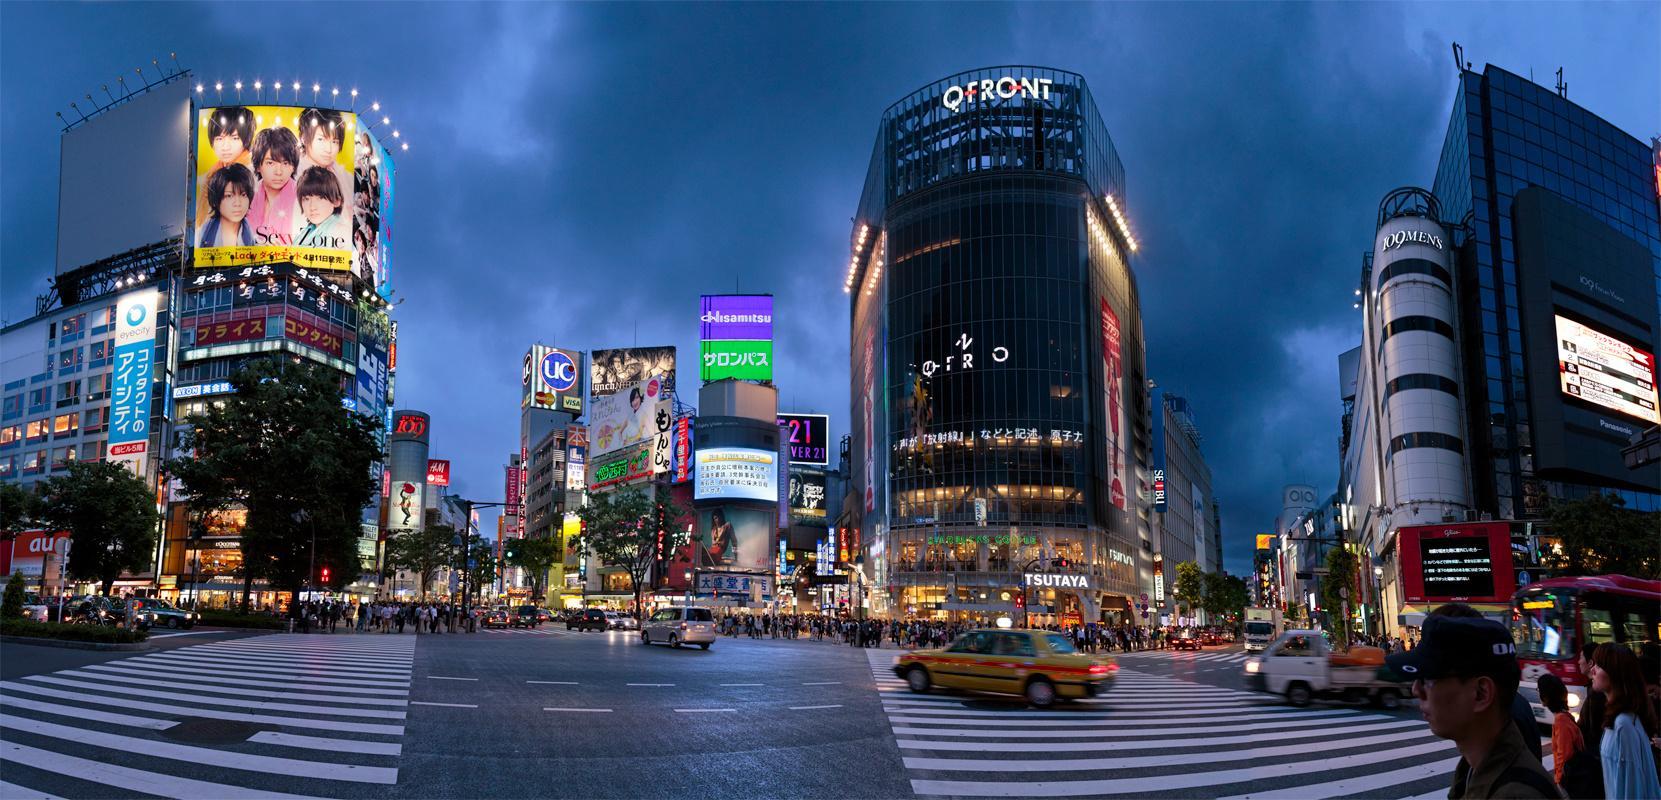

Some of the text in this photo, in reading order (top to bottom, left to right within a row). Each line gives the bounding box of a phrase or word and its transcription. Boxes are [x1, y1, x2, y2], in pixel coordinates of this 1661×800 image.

[255, 225, 345, 249] Sexy Zone
[235, 251, 257, 261] Lady
[701, 310, 772, 323] Hisamitsu
[119, 326, 150, 339] eyecity
[198, 319, 341, 352] プライス コンタクト
[704, 352, 769, 367] サロンパス
[545, 359, 574, 382] UC
[115, 352, 135, 435] アイシティ
[133, 349, 149, 433] コンタクトの
[176, 382, 229, 397] AEON 英会話
[565, 399, 580, 407] VISA
[397, 419, 425, 438] 109
[1600, 418, 1633, 436] Panasonic
[655, 408, 672, 469] もんじゃ
[791, 446, 825, 459] VER 21
[429, 462, 445, 473] H&M
[508, 468, 518, 512] Essential
[1154, 469, 1165, 505] SEIBU
[30, 537, 53, 552] au
[928, 535, 989, 545] SARBUCKS
[1024, 573, 1088, 588] TSUTAYA
